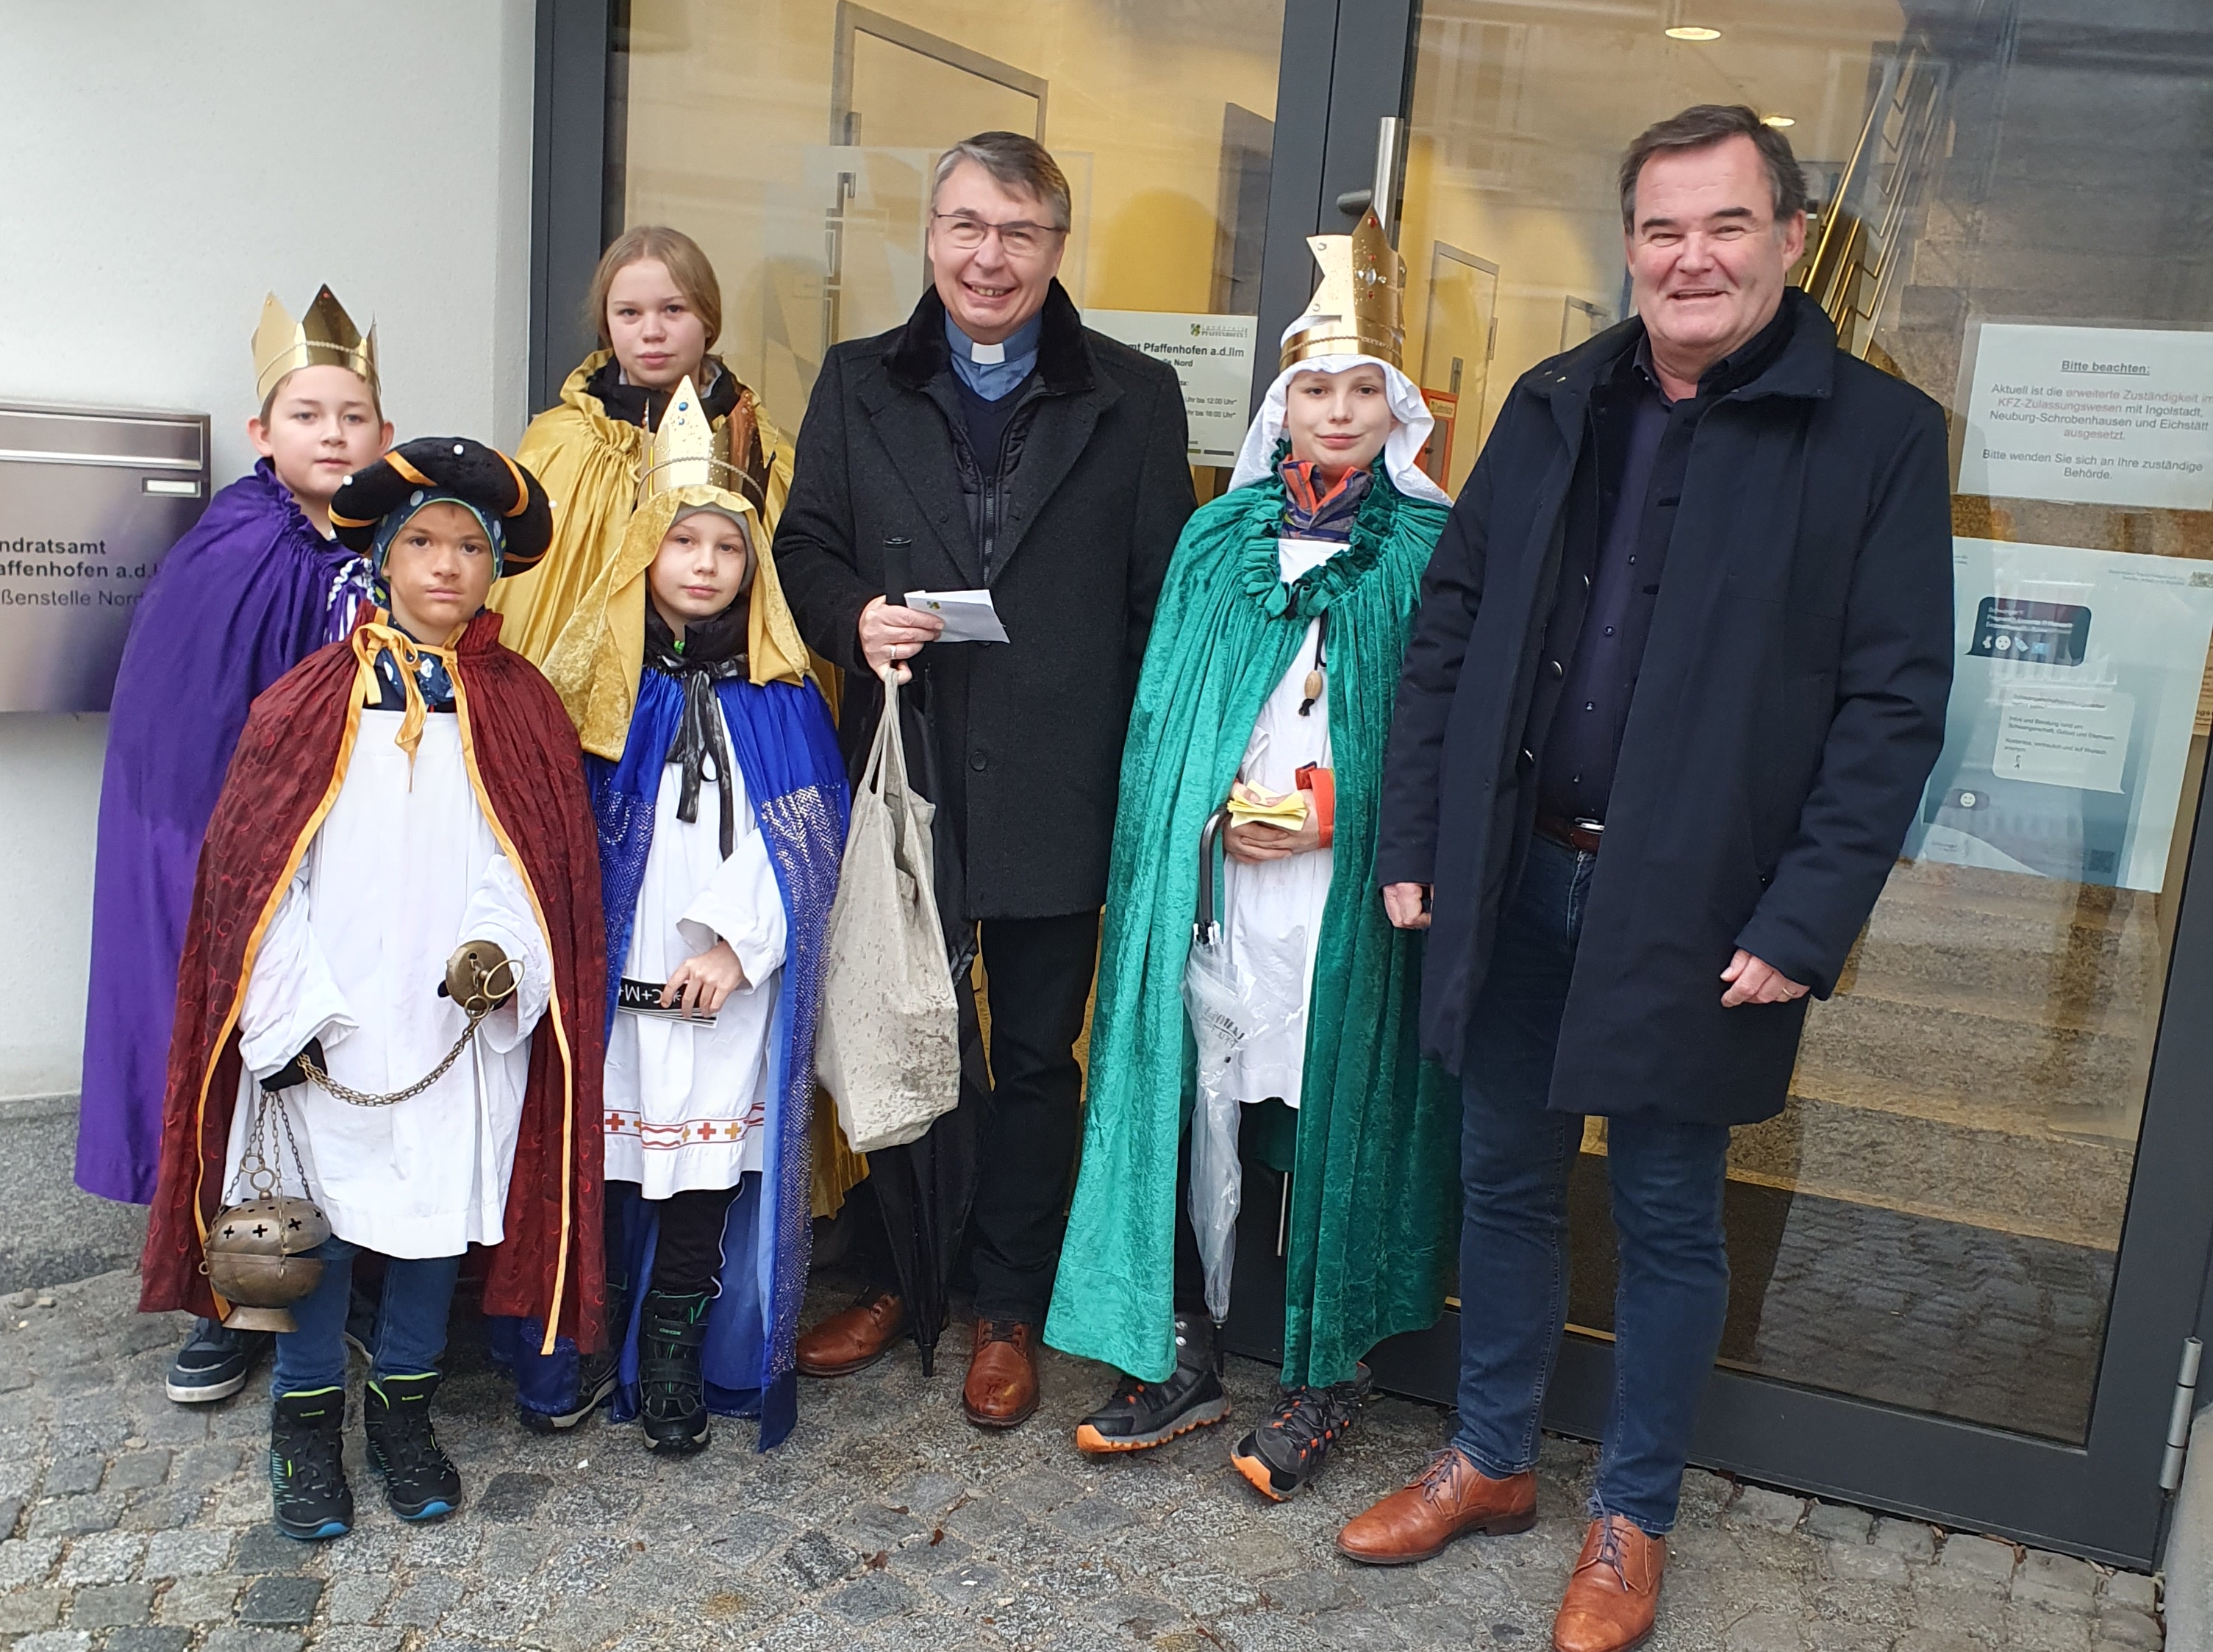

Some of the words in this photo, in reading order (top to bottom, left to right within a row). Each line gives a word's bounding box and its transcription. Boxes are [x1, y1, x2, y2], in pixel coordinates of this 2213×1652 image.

[1143, 343, 1207, 356] Pfaffenhofen
[1174, 359, 1193, 367] Nord
[2061, 360, 2089, 371] Bitte
[2092, 362, 2151, 374] beachten:
[1991, 384, 2028, 395] Aktuell
[2031, 386, 2043, 396] ist
[2046, 387, 2063, 396] die
[2066, 389, 2120, 399] erweiterte
[2123, 390, 2199, 404] Zuständigkeit
[1998, 398, 2122, 413] KFZ-Zulassungswesen
[2126, 404, 2142, 415] mit
[2145, 404, 2203, 418] Ingolstadt,
[1989, 410, 2132, 427] Neuburg-Schrobenhausen
[2135, 419, 2157, 429] und
[2160, 418, 2209, 432] Eichstätt
[2064, 429, 2125, 440] ausgesetzt.
[1982, 448, 2006, 460] Bitte
[2009, 453, 2051, 462] wenden
[2055, 453, 2072, 464] Sie
[2076, 455, 2097, 465] sich
[2100, 458, 2114, 466] an
[2117, 457, 2139, 468] Ihre
[2142, 460, 2203, 473] zuständige
[2064, 467, 2112, 479] Behörde.
[1, 588, 91, 606] ßenstelle
